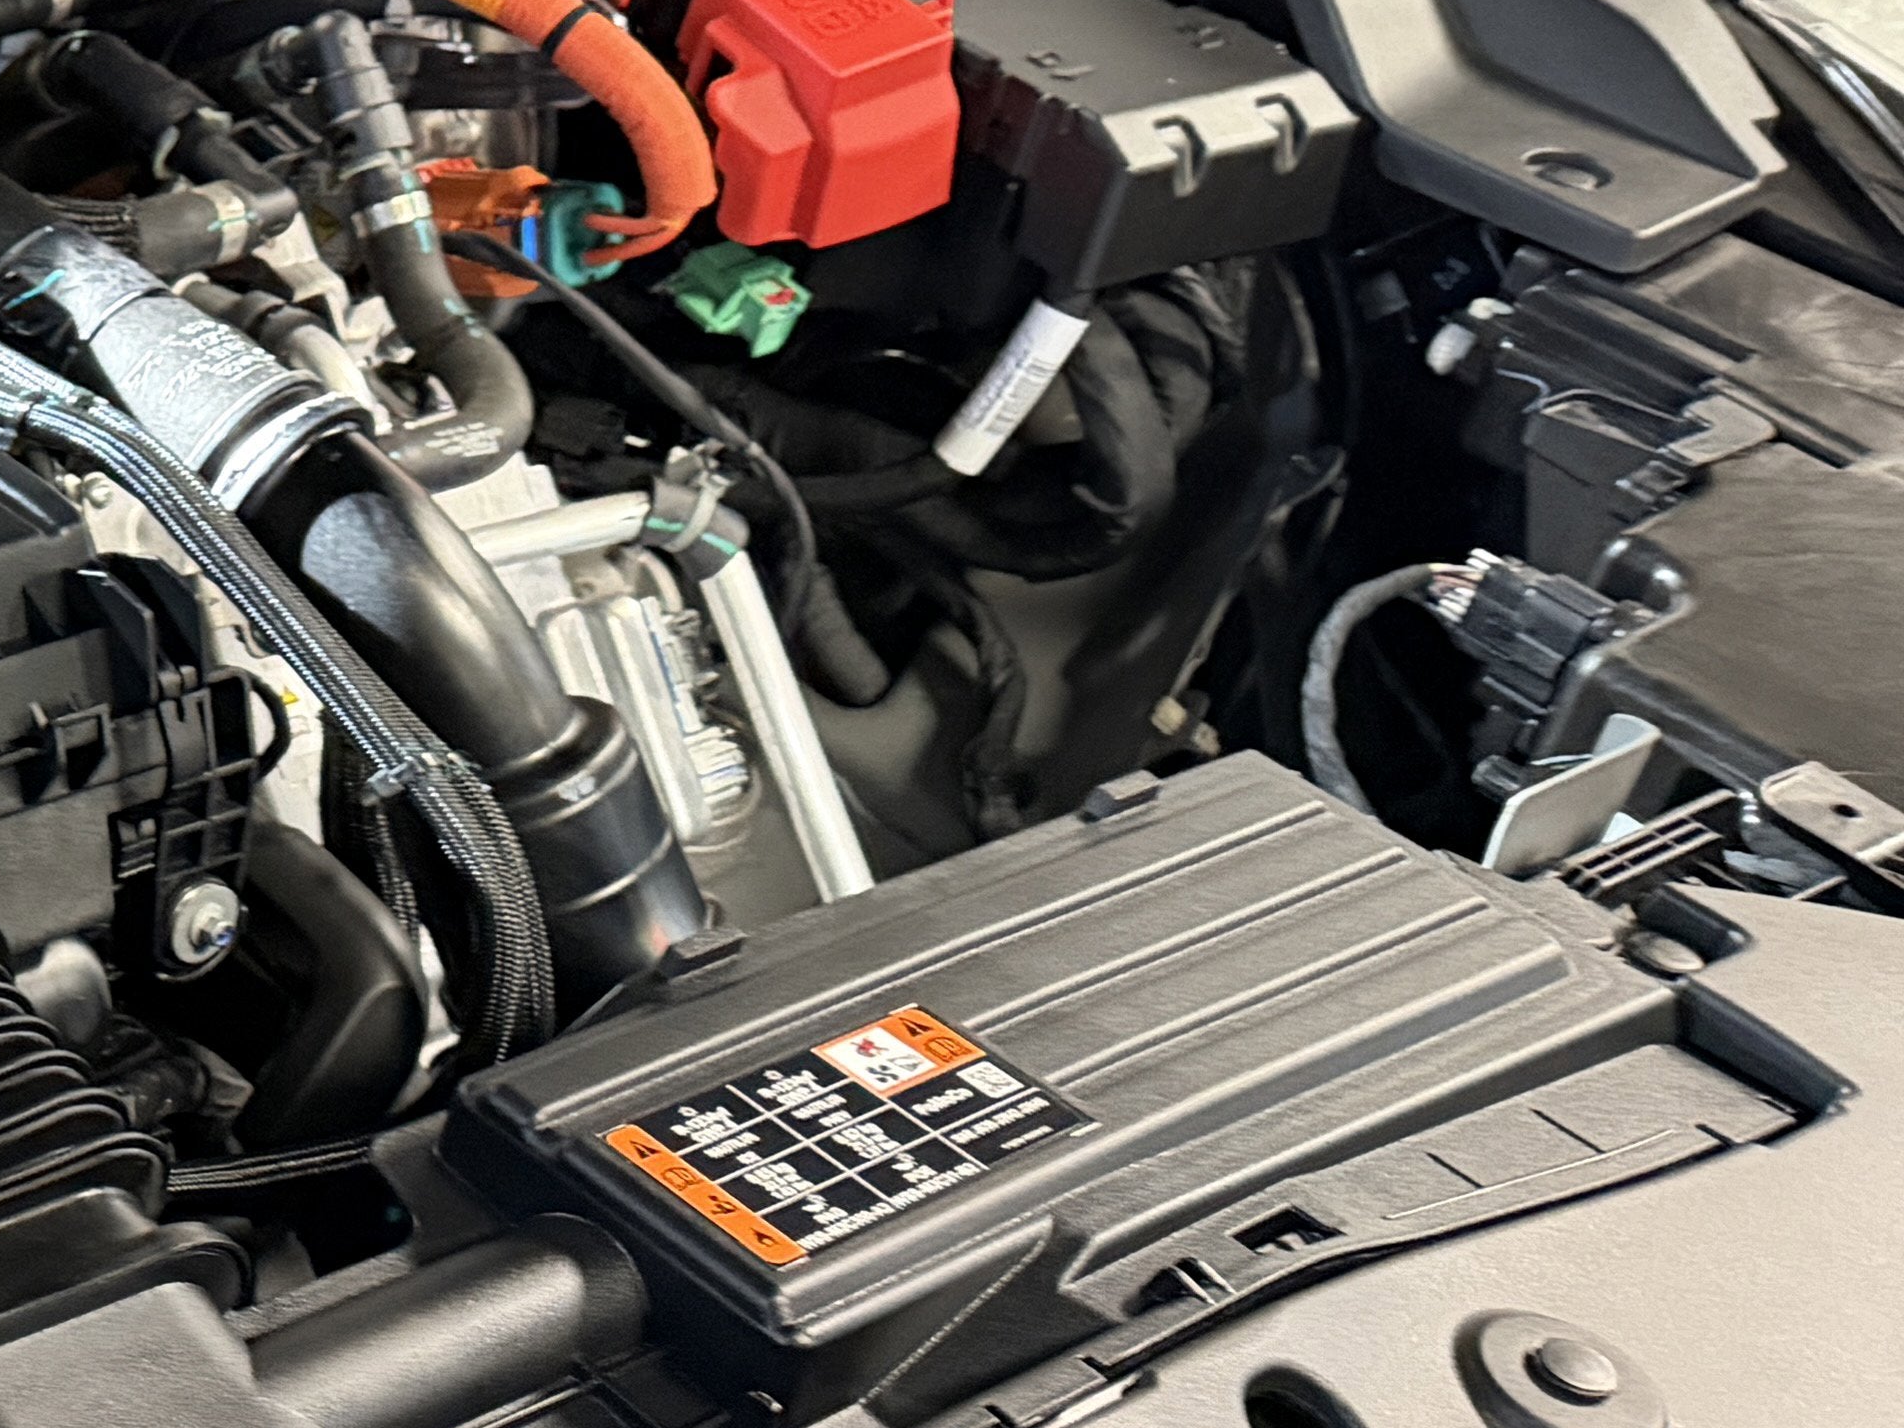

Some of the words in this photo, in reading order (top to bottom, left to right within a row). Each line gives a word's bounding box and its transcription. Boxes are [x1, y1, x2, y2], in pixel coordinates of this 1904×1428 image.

[791, 1094, 847, 1119] NAUTILUS
[911, 1088, 974, 1115] FoMoCo
[703, 1132, 760, 1158] NAUTILUS
